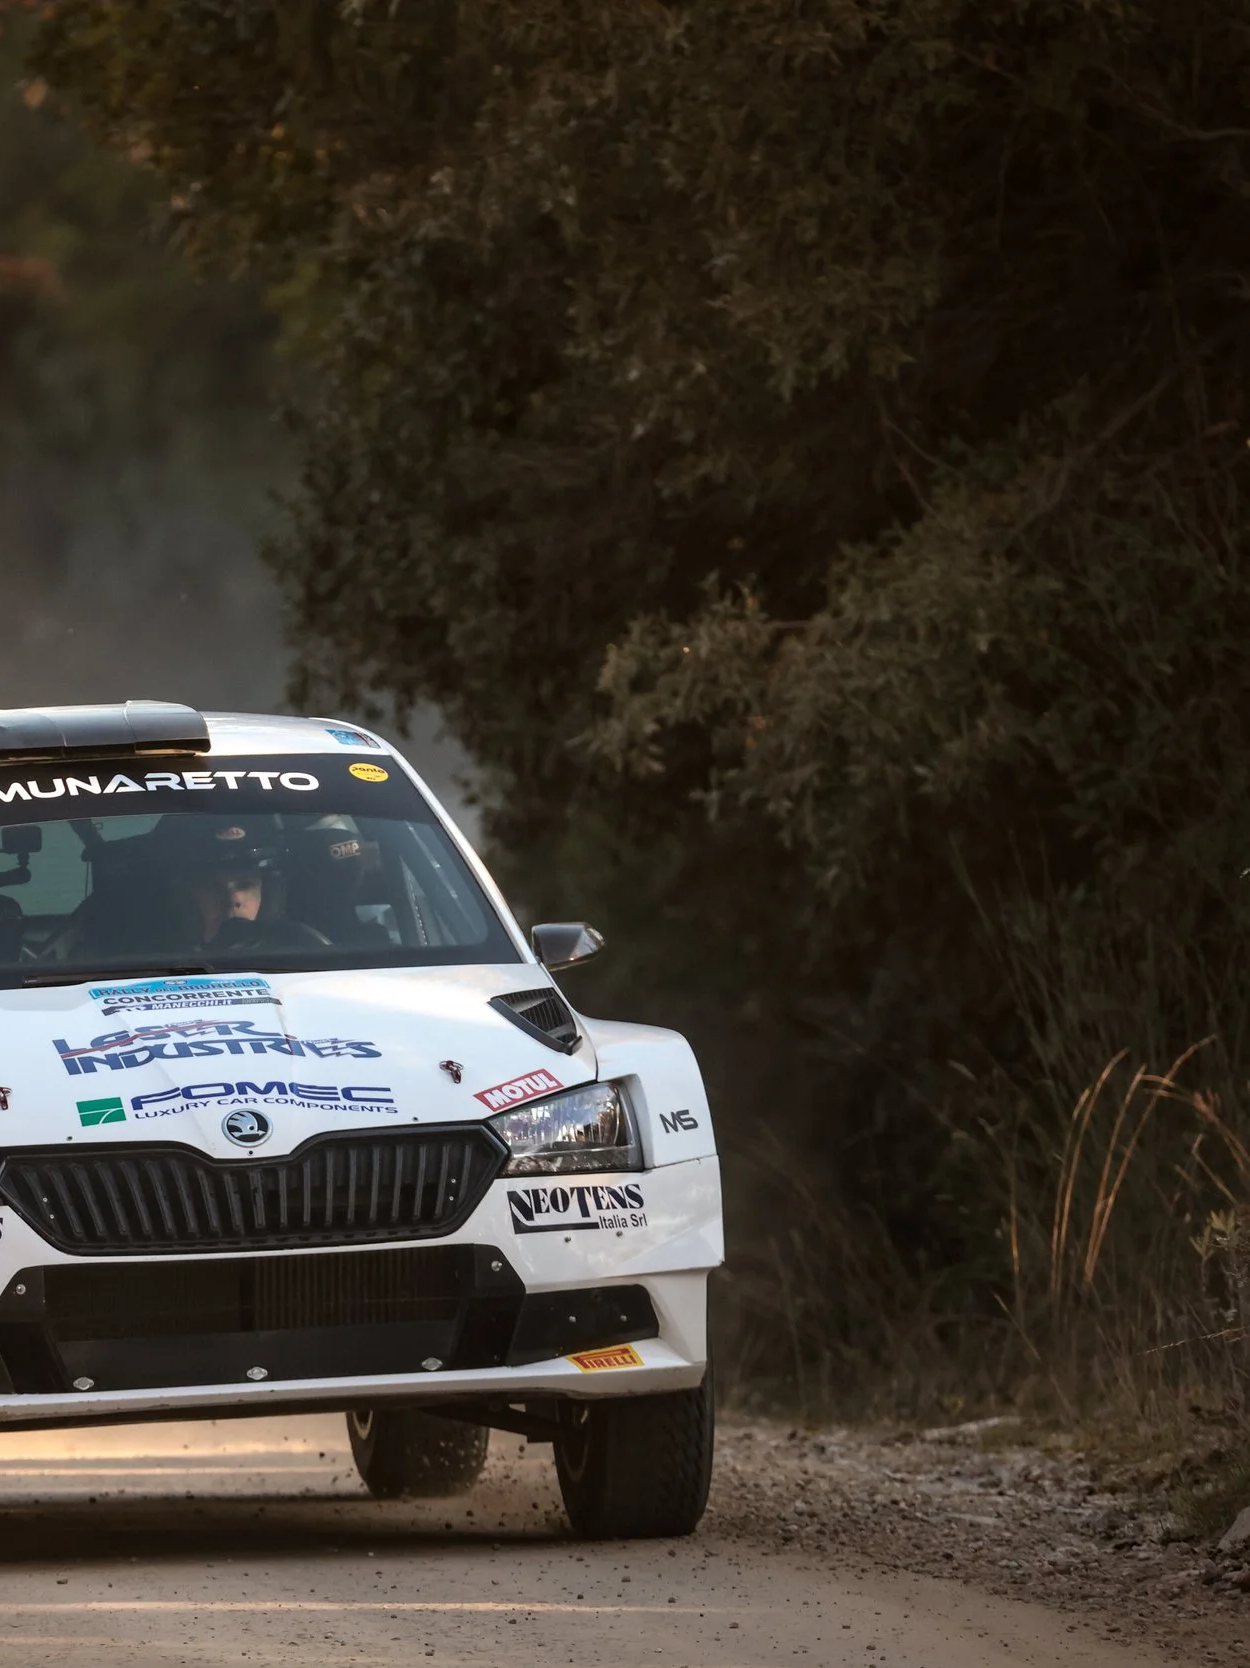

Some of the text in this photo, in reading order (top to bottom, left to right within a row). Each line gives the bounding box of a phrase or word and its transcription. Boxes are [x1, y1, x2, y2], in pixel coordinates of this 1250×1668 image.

[331, 842, 359, 857] OMP
[98, 987, 150, 996] RALLY
[178, 981, 261, 991] BRUNELLO
[103, 988, 270, 1005] CONCORRENTE
[63, 1037, 382, 1075] INDUSTRIES
[131, 1081, 395, 1110] FOMEC
[483, 1072, 558, 1109] MOTUL
[135, 1097, 399, 1119] LUXURY CAR COMPONENTS
[659, 1109, 699, 1134] MS
[507, 1184, 645, 1222] NEOTENS
[599, 1213, 647, 1229] Italia Srl
[571, 1347, 637, 1369] PIRELLI
